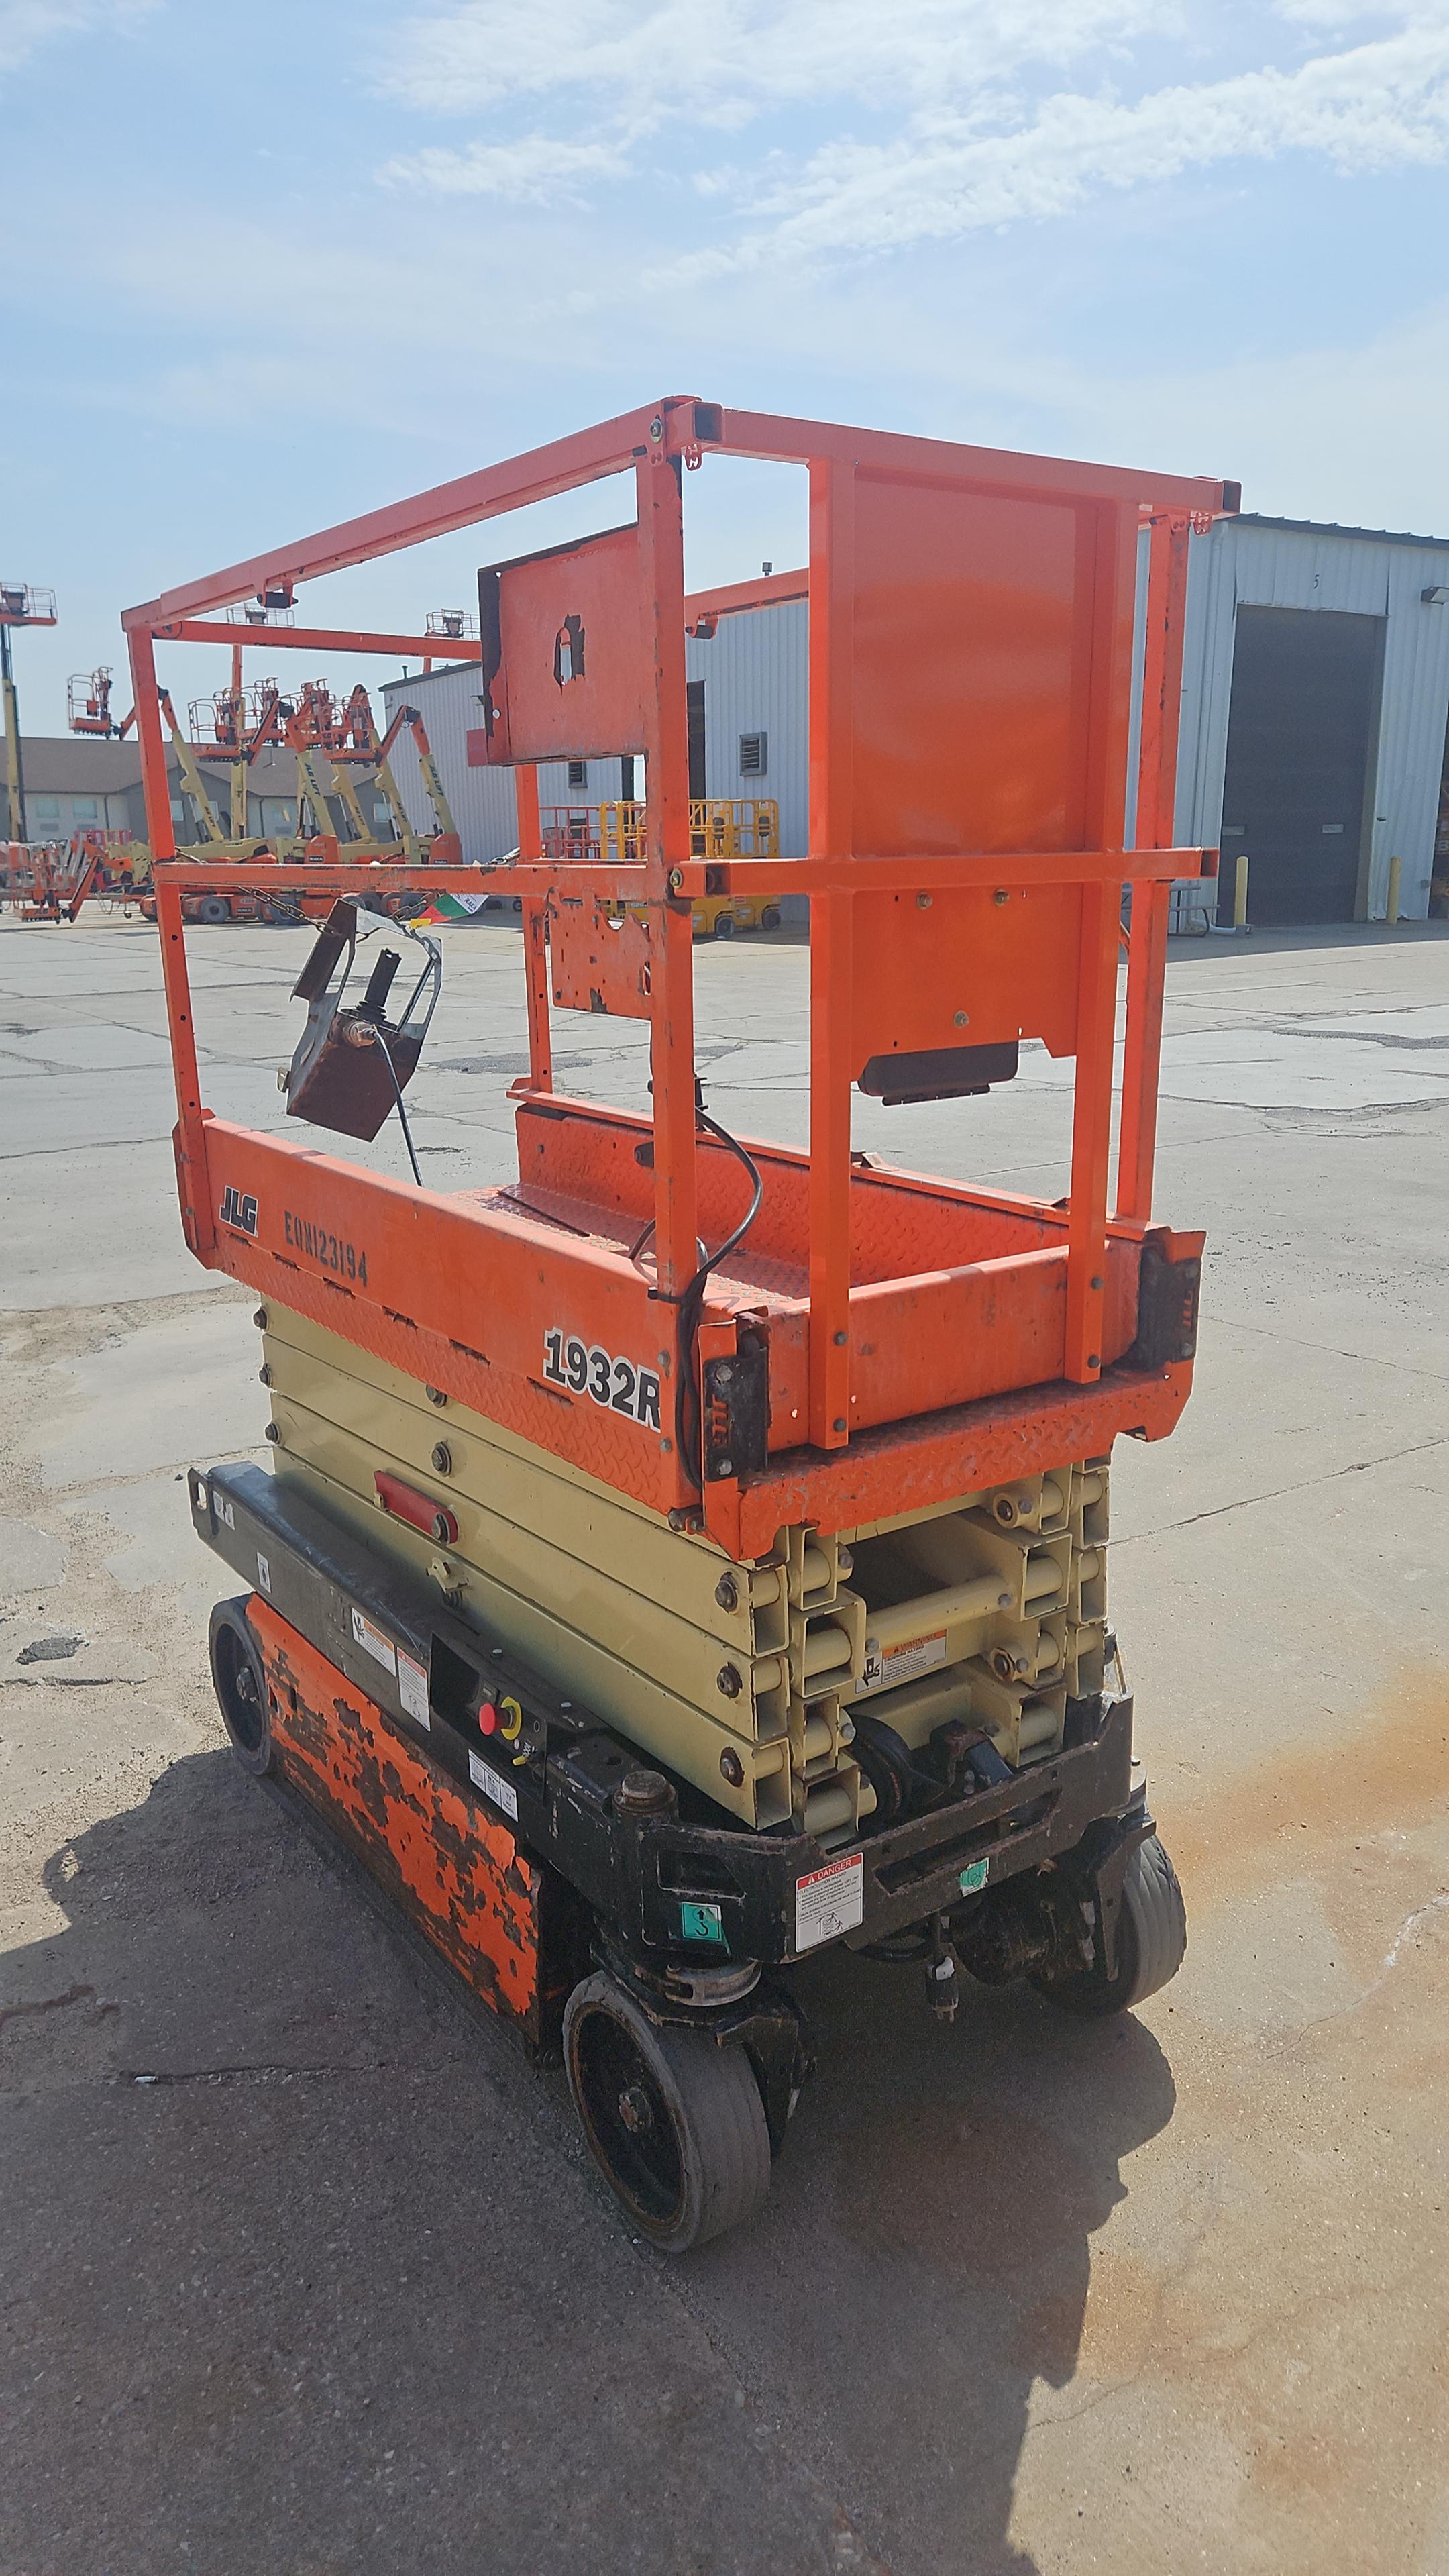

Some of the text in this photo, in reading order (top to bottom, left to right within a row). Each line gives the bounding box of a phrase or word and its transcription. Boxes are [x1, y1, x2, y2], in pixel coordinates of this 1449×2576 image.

[219, 1185, 258, 1237] JLG
[544, 1329, 661, 1432] 1932R
[817, 1859, 852, 1880] DANGER
